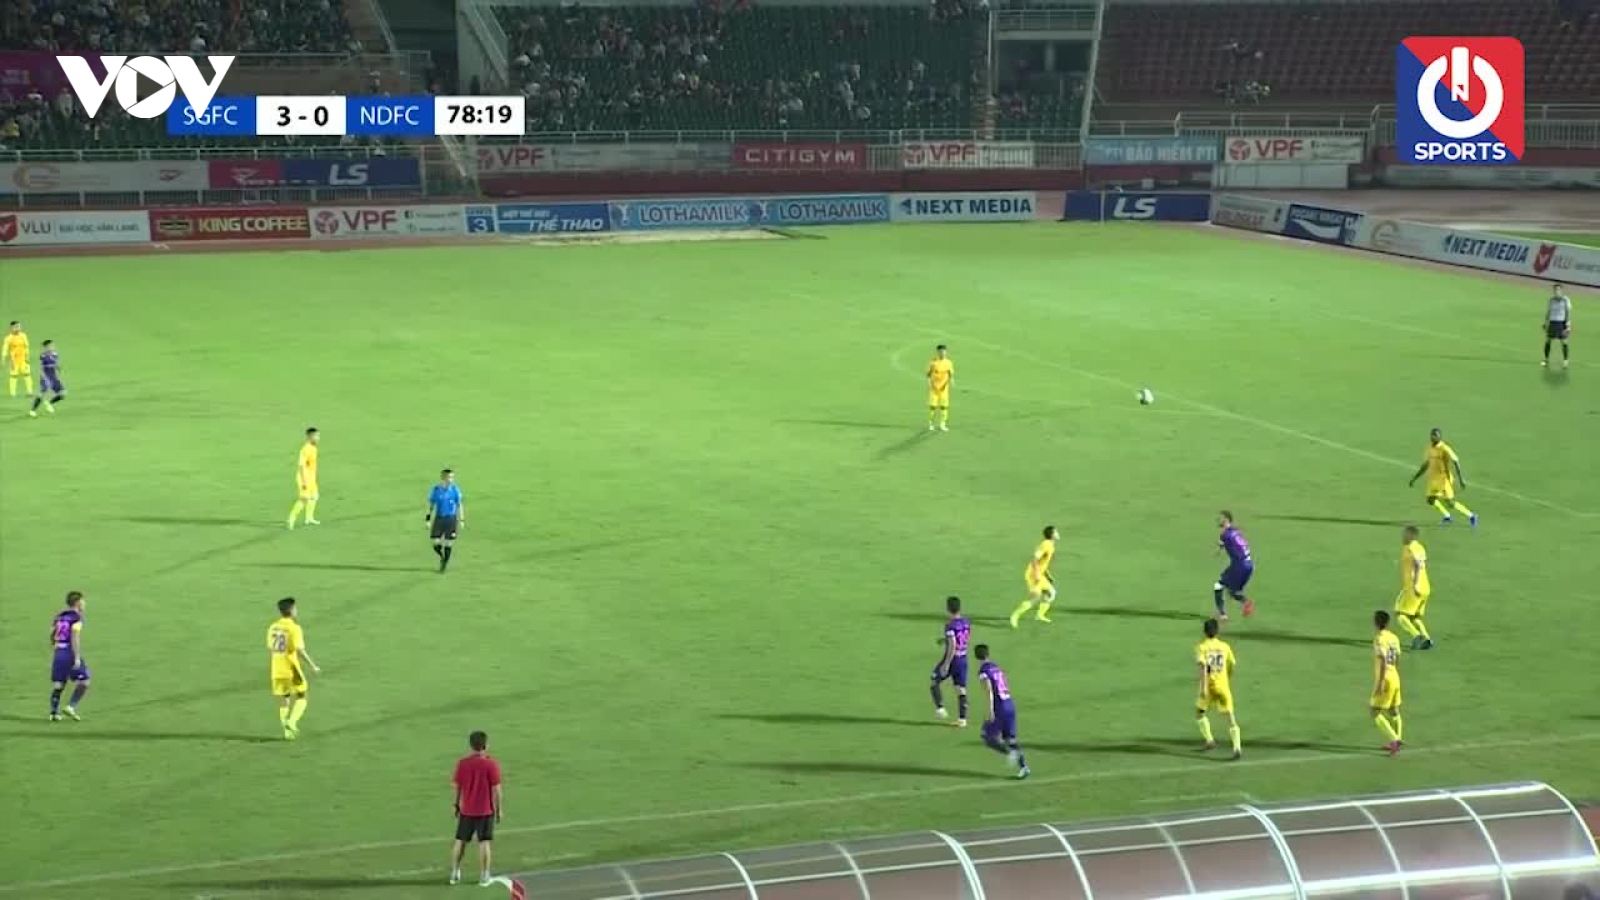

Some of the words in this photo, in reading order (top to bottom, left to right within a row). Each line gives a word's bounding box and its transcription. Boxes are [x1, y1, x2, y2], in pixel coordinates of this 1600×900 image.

[499, 149, 545, 167] VPF
[745, 150, 855, 164] CITIGYM
[928, 145, 978, 161] VPF
[1255, 140, 1303, 158] VPF
[329, 164, 369, 185] LS
[639, 205, 748, 223] LOTHAMILK
[778, 201, 884, 221] LOTHAMILK
[917, 199, 963, 216] NEXT
[970, 199, 1032, 214] MEDIA
[1112, 198, 1157, 218] LS
[21, 221, 51, 234] VLU
[199, 217, 242, 231] KING
[243, 216, 308, 231] COFFEE
[343, 211, 396, 230] VPF
[474, 218, 488, 232] 3
[561, 219, 603, 231] THAO
[1450, 236, 1486, 256] NEXT
[1485, 242, 1529, 264] MEDIA
